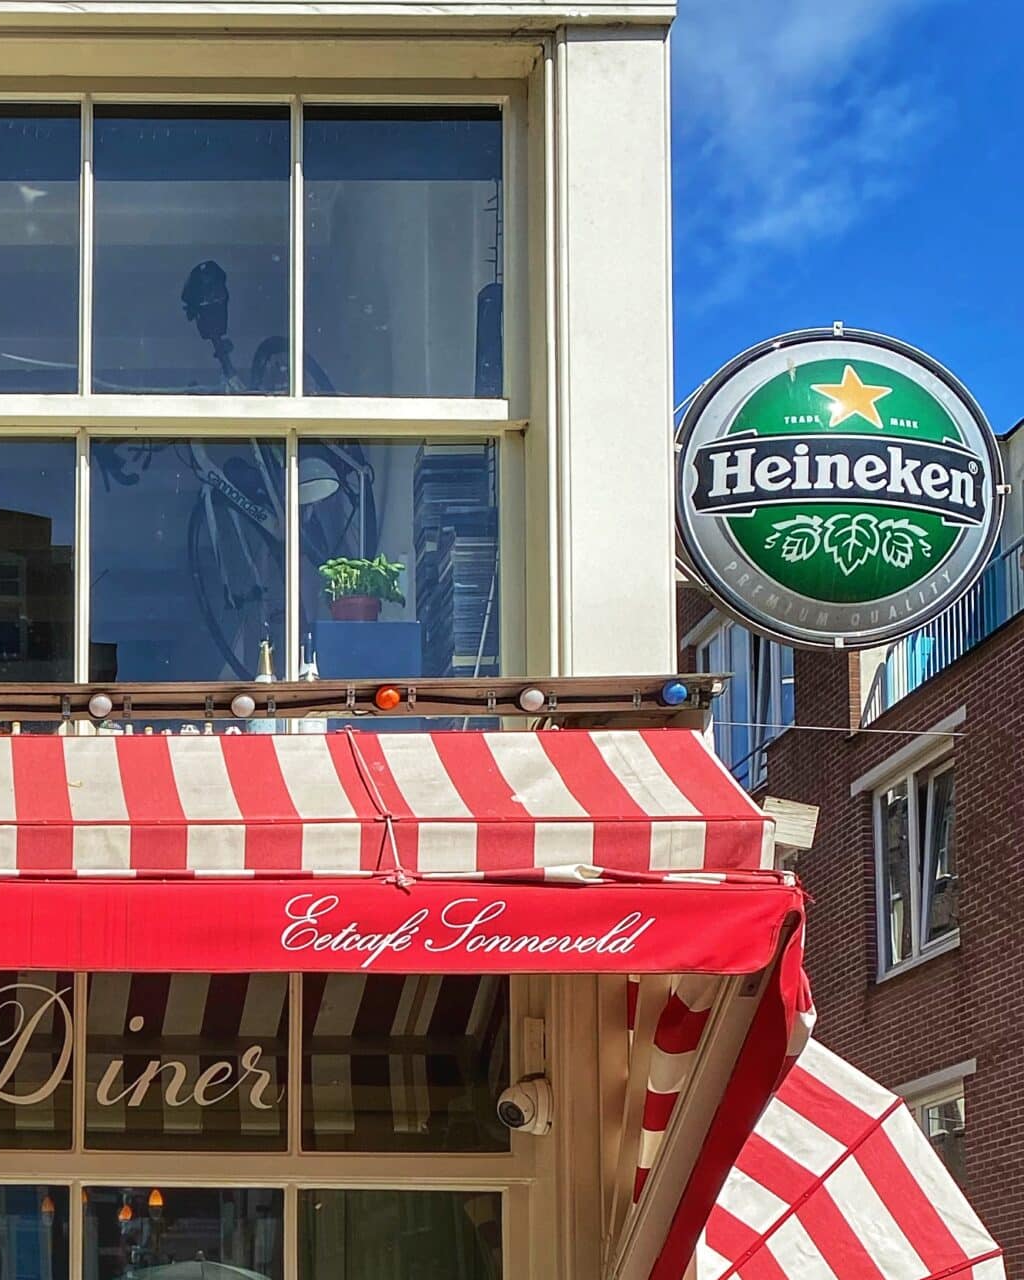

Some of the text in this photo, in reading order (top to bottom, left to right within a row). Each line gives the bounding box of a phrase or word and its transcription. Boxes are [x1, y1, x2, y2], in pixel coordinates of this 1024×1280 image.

[784, 415, 919, 429] TRADE MARK
[724, 561, 952, 626] PREMIUM QUALITY
[279, 893, 656, 968] Eetcafé Sonneveld
